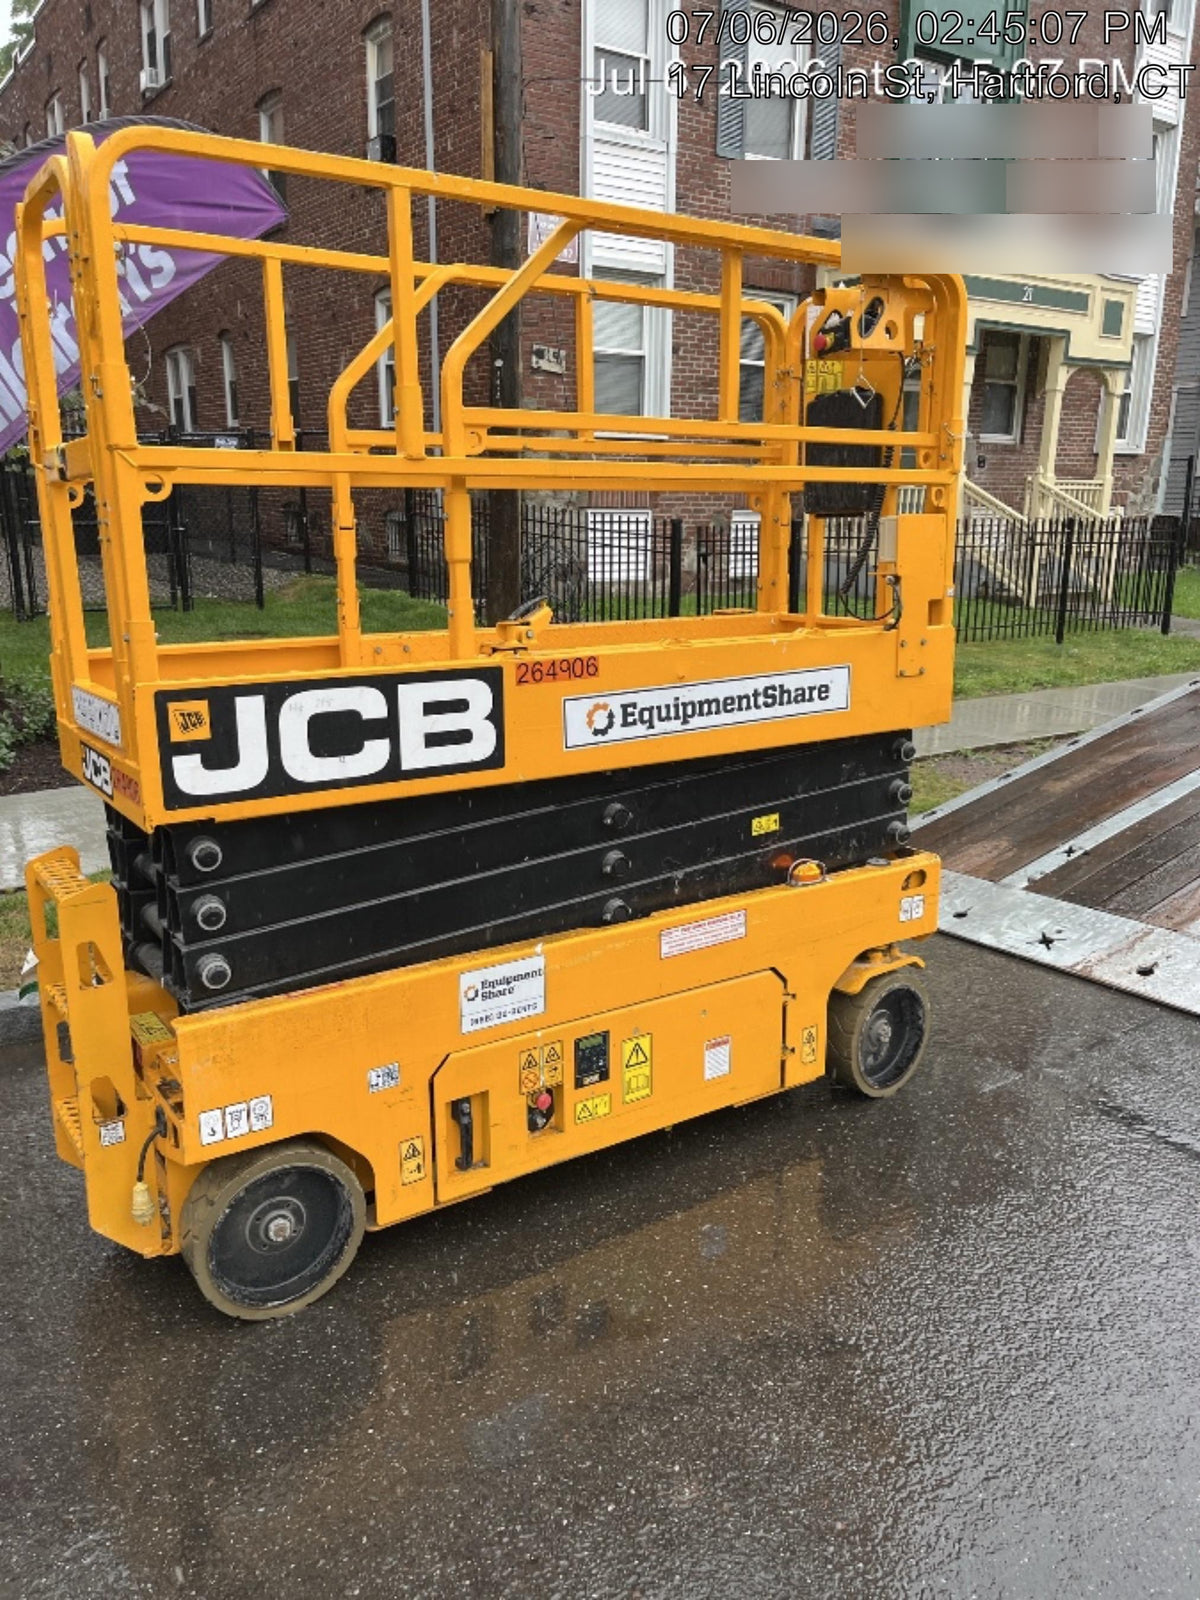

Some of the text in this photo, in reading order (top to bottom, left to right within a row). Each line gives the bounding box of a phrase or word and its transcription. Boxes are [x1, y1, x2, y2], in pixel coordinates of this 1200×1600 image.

[516, 656, 599, 684] 264906
[620, 682, 830, 730] EquipmentShare
[171, 678, 497, 796] JCB
[81, 743, 112, 797] JCB
[480, 967, 544, 991] Equipment
[480, 986, 515, 1002] Share
